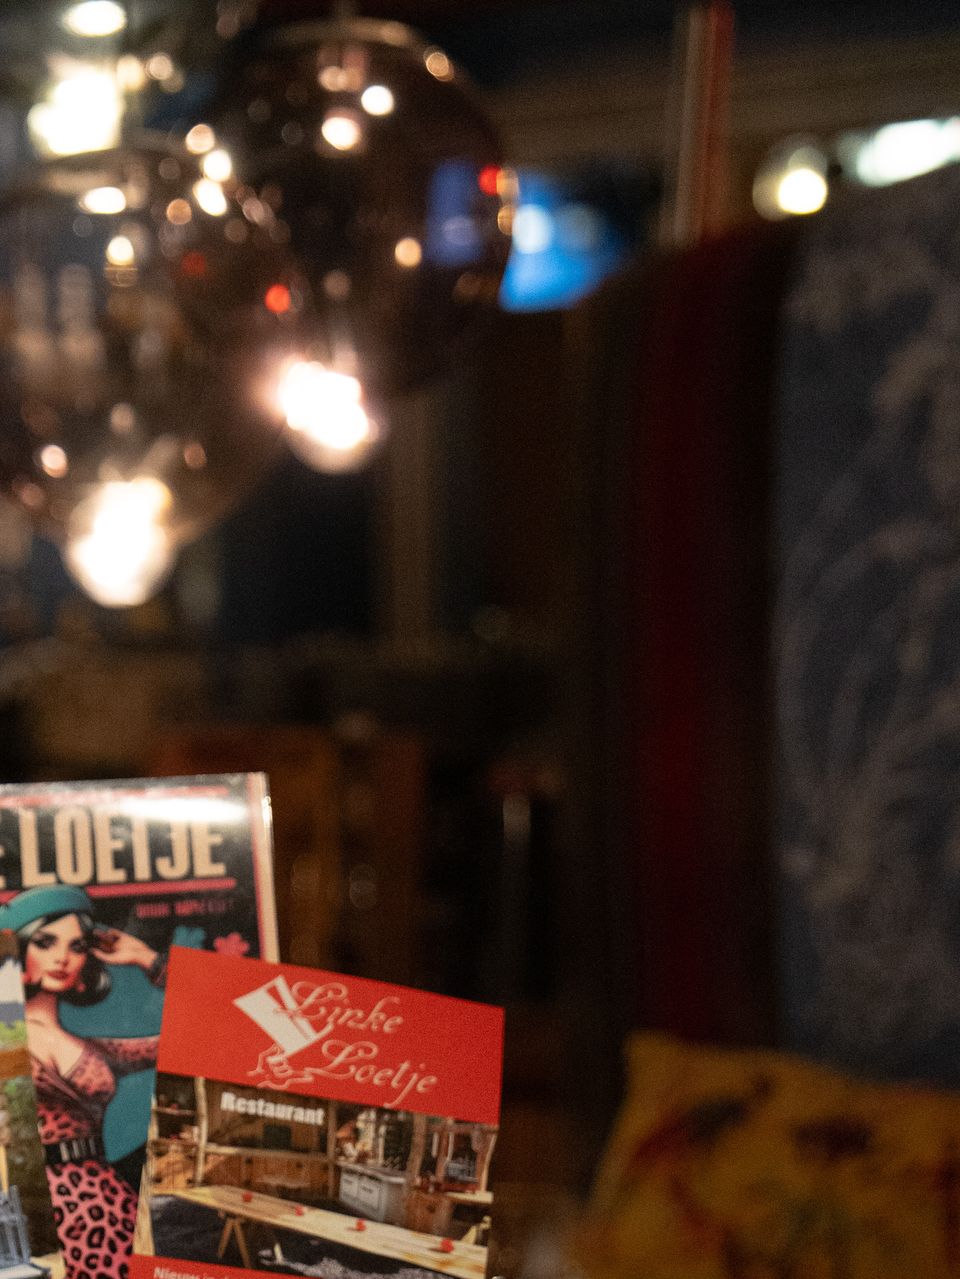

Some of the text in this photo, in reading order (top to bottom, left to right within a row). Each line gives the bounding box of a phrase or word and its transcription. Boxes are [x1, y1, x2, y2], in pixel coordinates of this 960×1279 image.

[276, 981, 404, 1034] Linke
[308, 1039, 438, 1108] Loetje
[220, 1091, 325, 1126] Restaurant
